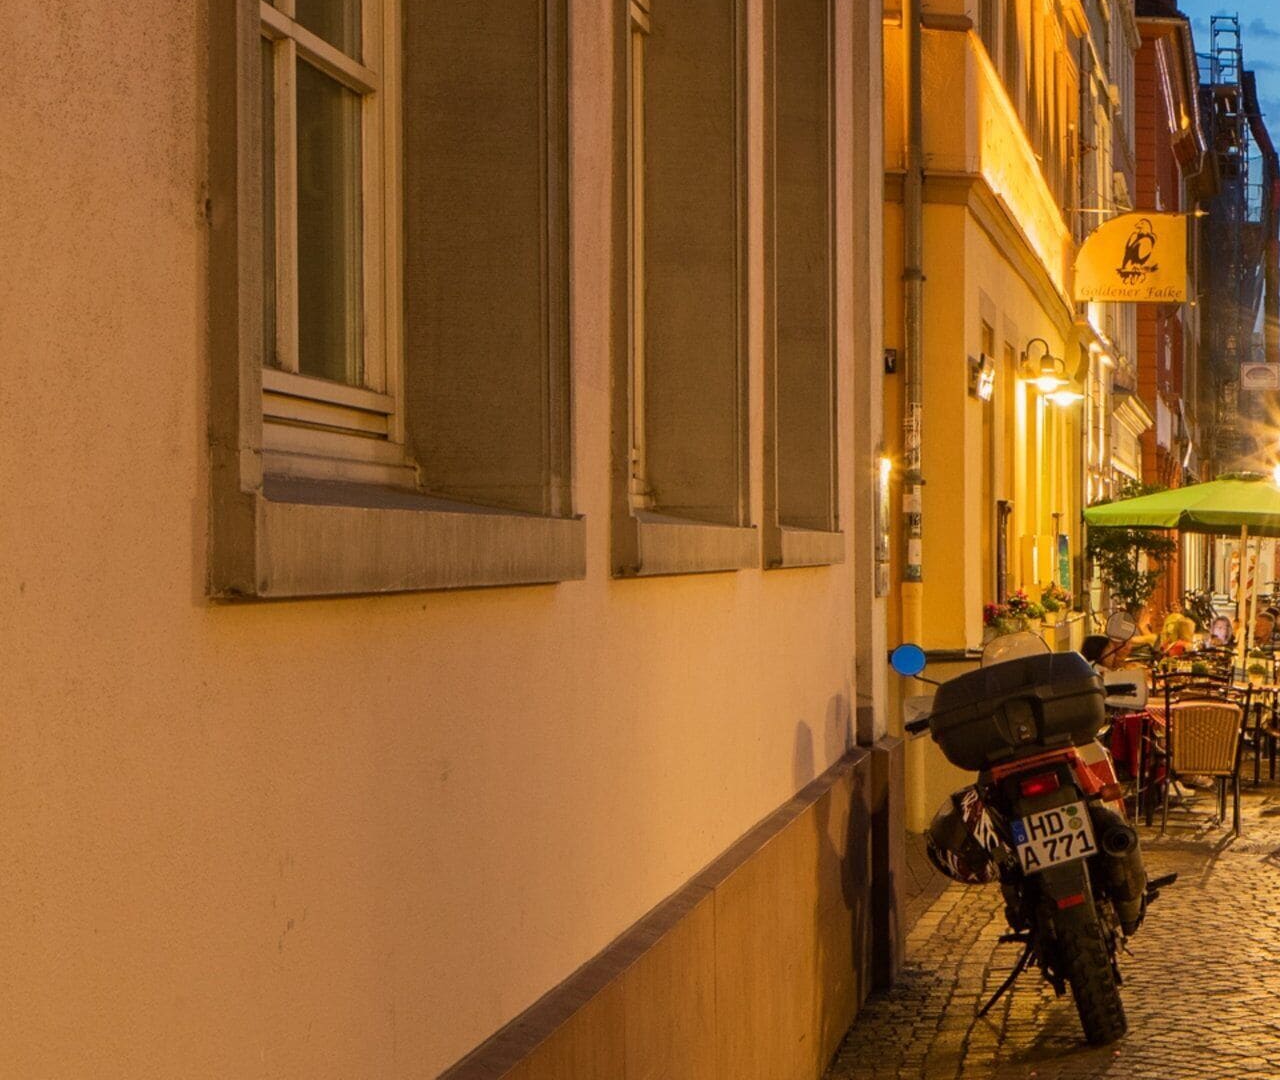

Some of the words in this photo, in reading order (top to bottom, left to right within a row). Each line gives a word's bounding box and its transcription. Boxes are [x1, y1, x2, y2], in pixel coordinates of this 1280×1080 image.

[1081, 286, 1140, 297] Goldener
[1144, 286, 1182, 299] Falke
[1027, 812, 1064, 840] HD
[1024, 846, 1040, 870] A
[1043, 830, 1094, 861] 771
